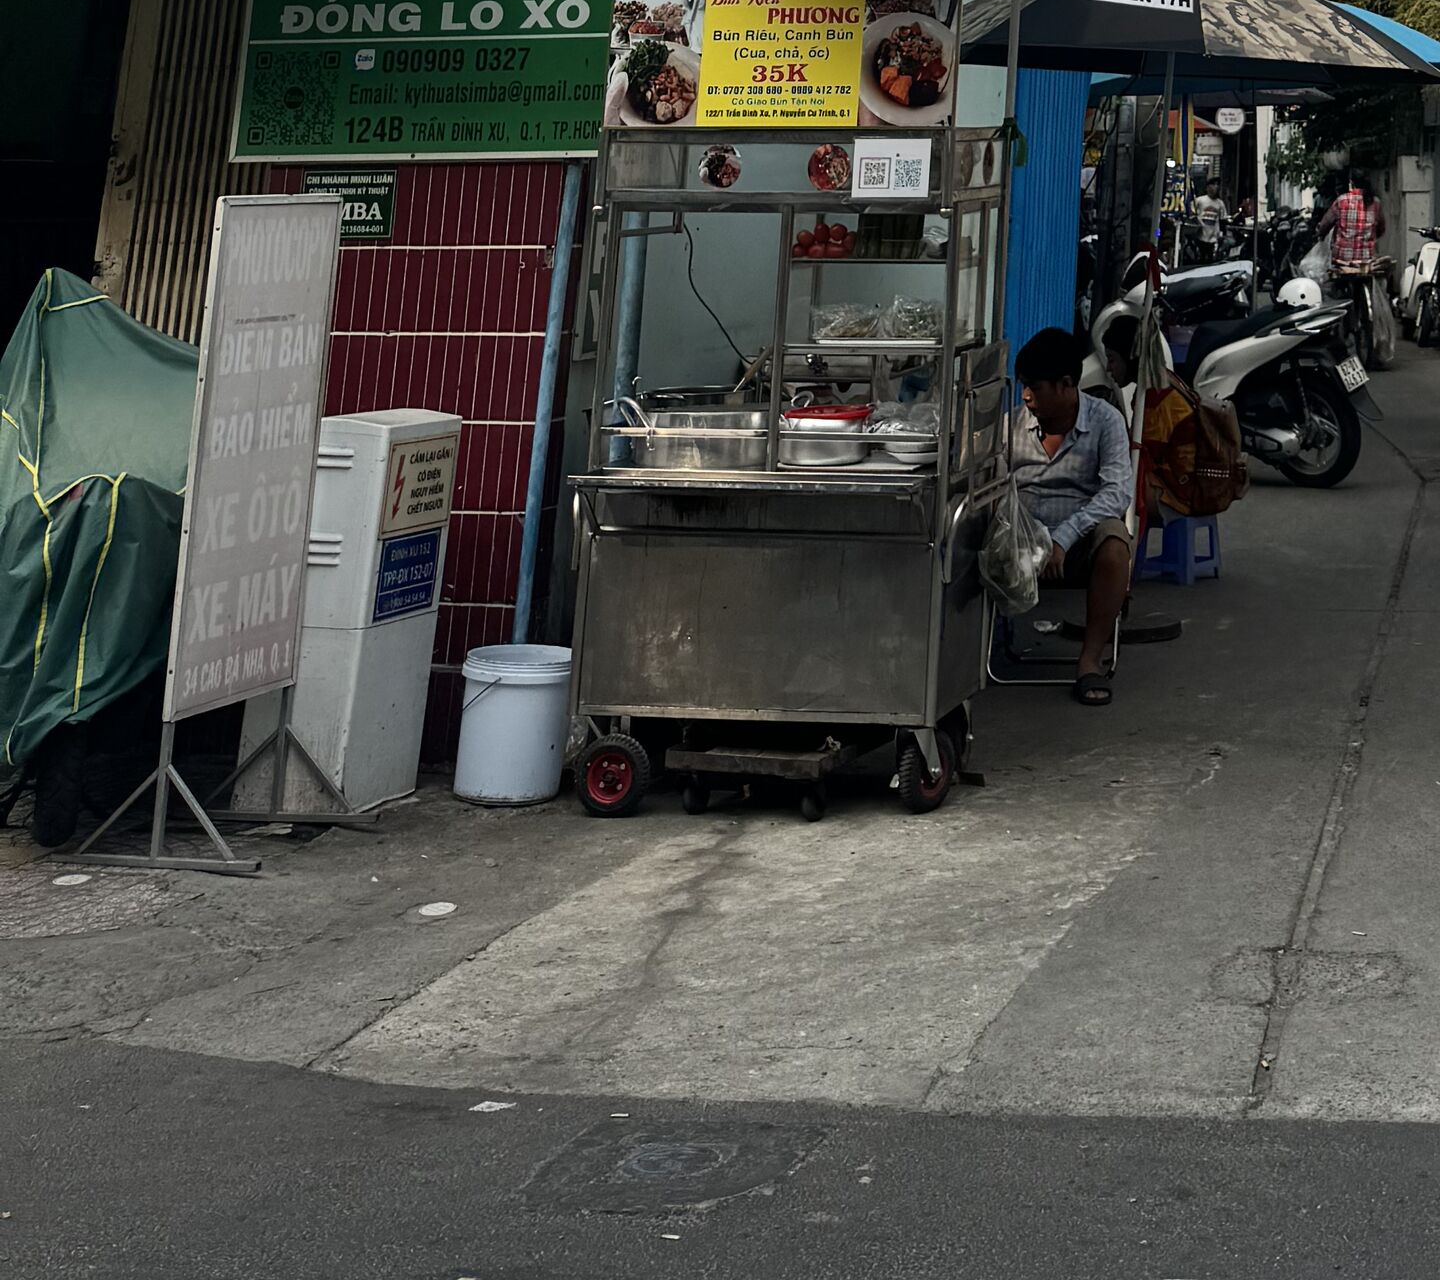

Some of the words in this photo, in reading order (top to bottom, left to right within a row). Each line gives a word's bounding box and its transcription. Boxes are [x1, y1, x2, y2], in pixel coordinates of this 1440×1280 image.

[767, 6, 860, 25] PHƯƠNG
[713, 28, 740, 41] Bún
[785, 29, 821, 41] Canh
[826, 28, 854, 41] Bún
[382, 48, 465, 73] 090909
[475, 47, 531, 72] 0327
[734, 47, 770, 61] (Cua,
[774, 45, 804, 60] chả,
[808, 45, 830, 60] ốc)
[751, 63, 809, 83] 35K
[345, 114, 404, 144] 124B
[199, 492, 240, 555] XE
[188, 580, 229, 645] XE
[235, 552, 300, 634] MÁY
